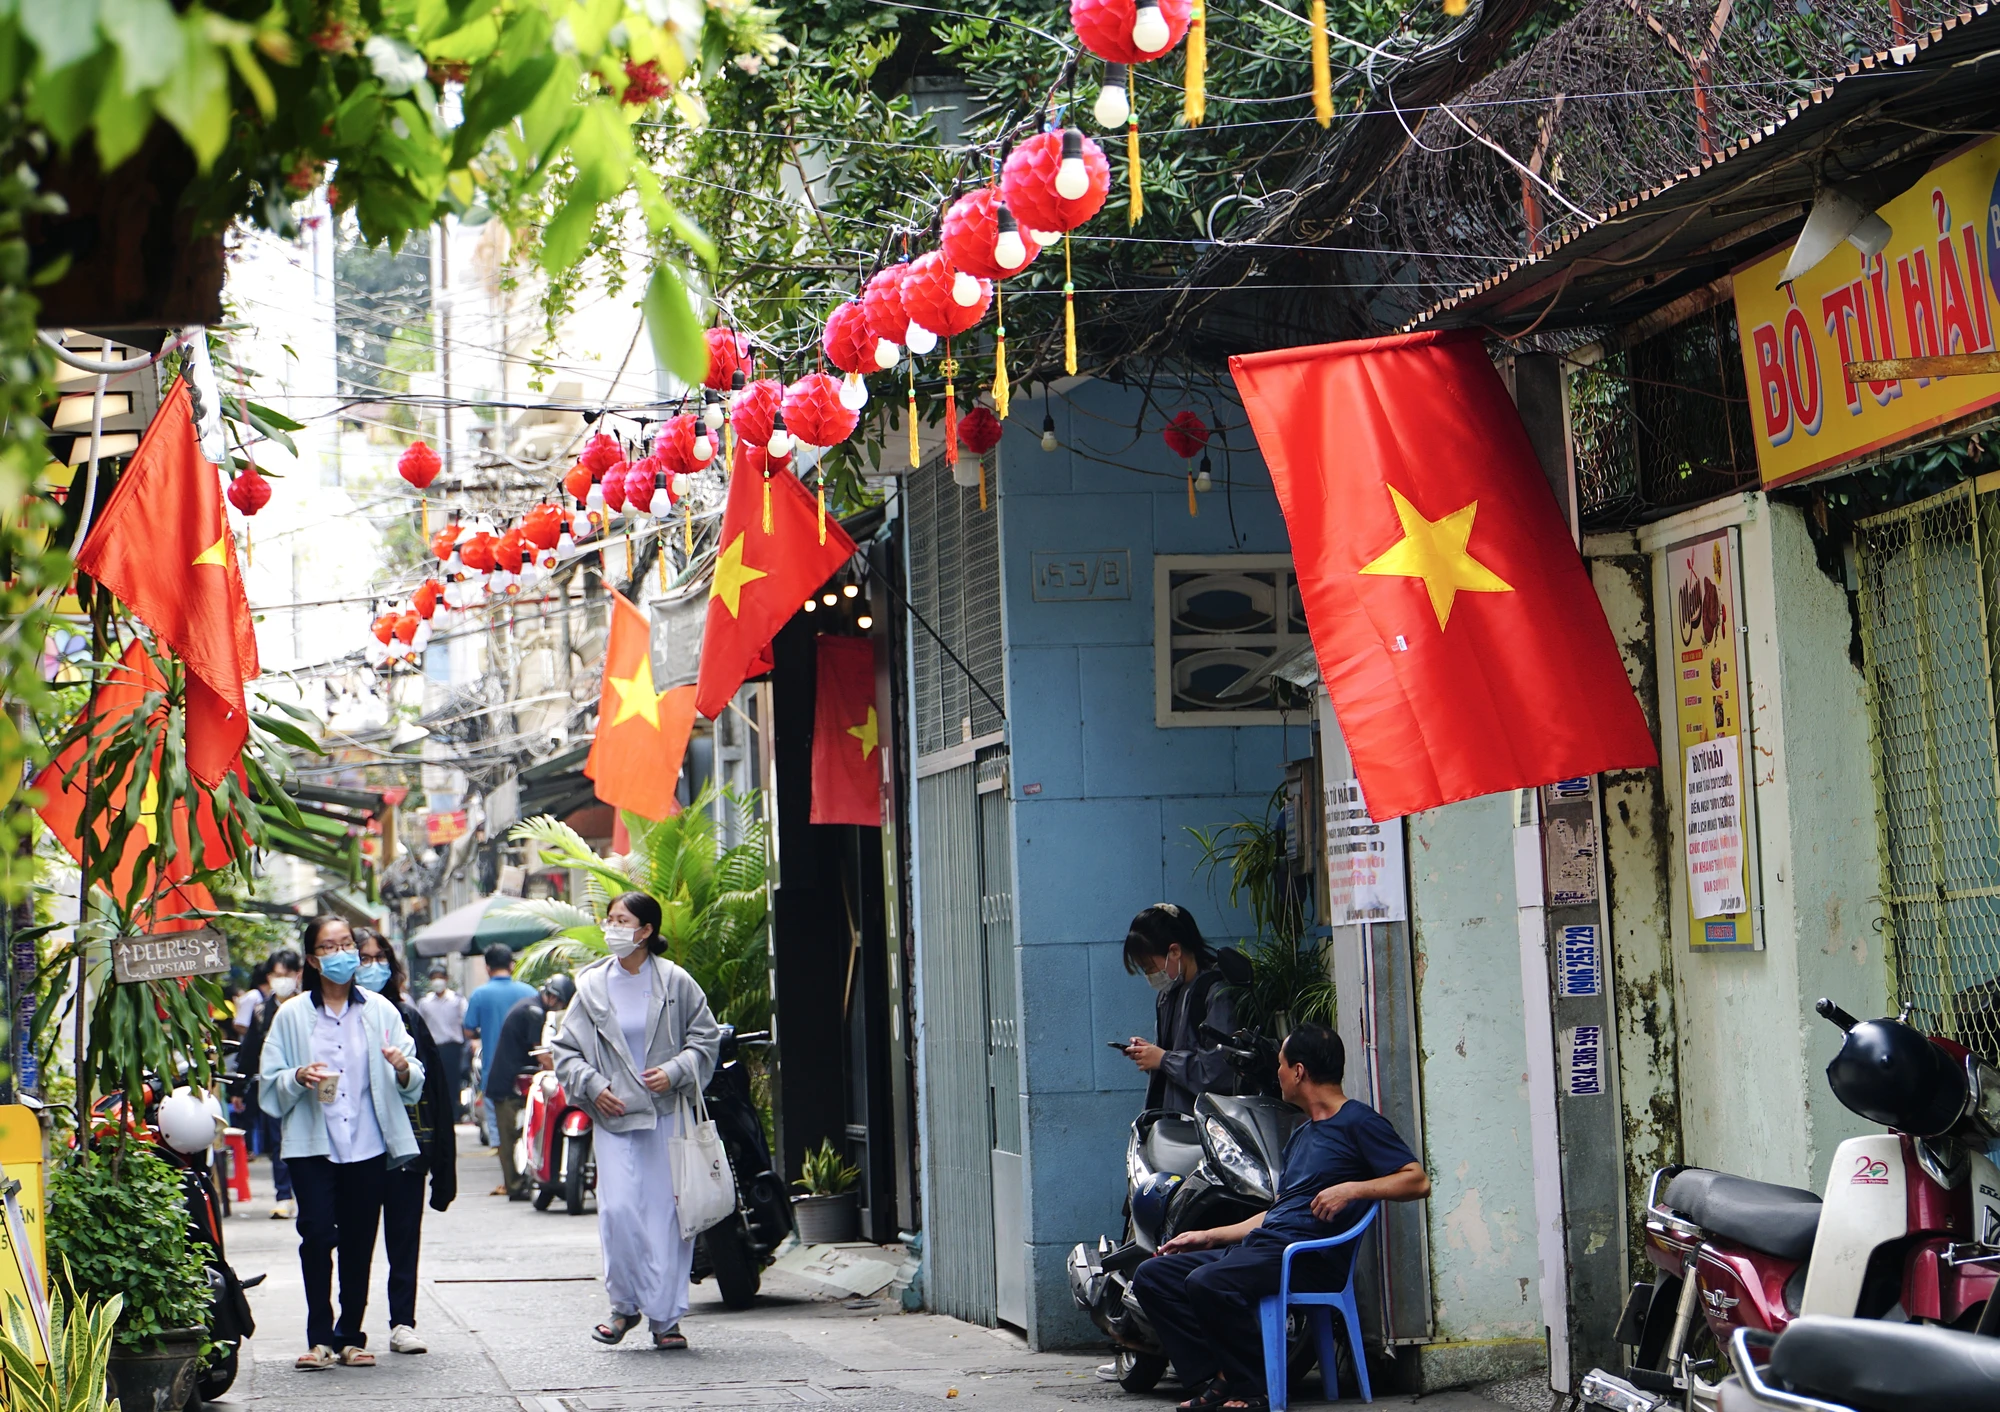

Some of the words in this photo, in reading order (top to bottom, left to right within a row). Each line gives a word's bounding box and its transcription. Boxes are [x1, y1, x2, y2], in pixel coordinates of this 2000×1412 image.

[1752, 280, 1822, 444] BÒ
[1897, 187, 1998, 386] HẢI
[1679, 576, 1703, 647] Menu
[1707, 744, 1724, 769] HẢI
[881, 746, 900, 1041] MILANO
[1565, 926, 1595, 945] 229
[132, 939, 200, 961] DEERUS
[1565, 946, 1595, 967] 255
[150, 960, 197, 975] UPSTAIR
[1567, 968, 1596, 995] 0906
